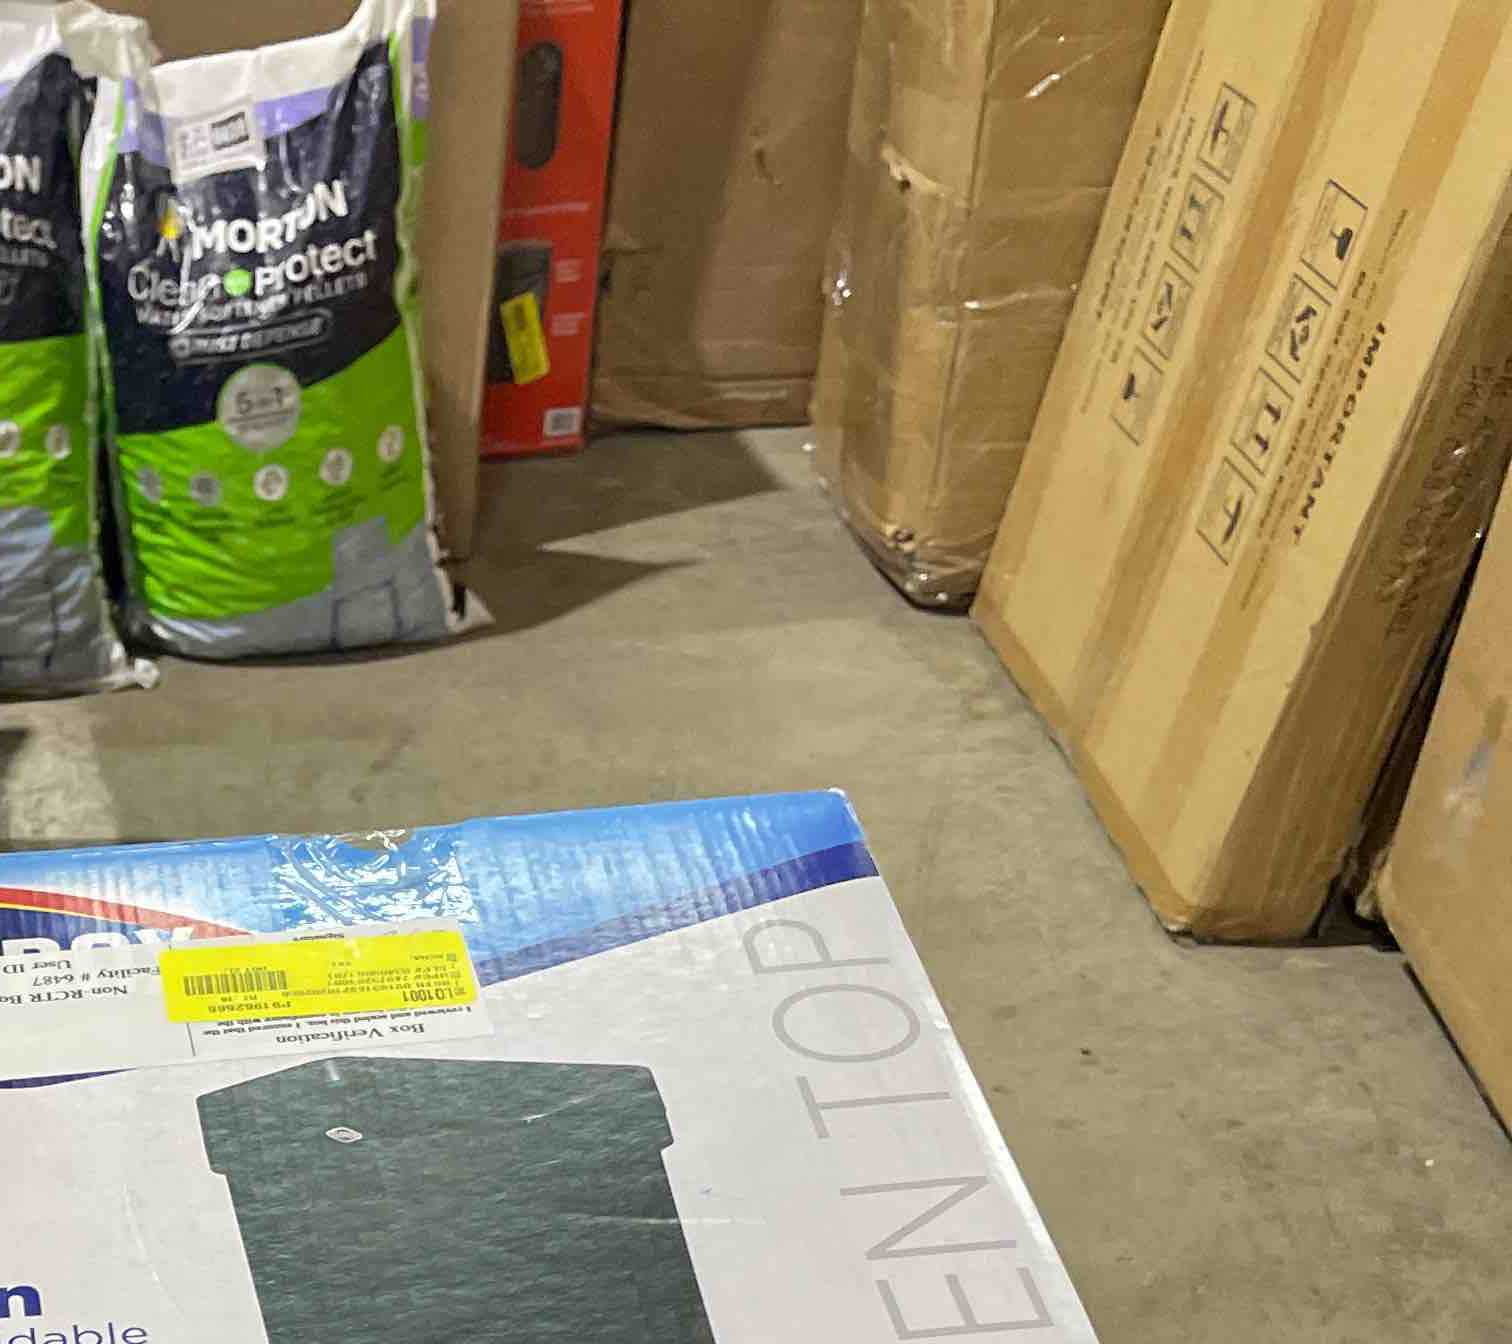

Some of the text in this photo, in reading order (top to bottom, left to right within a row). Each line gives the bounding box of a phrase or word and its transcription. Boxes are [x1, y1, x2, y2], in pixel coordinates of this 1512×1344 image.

[254, 230, 376, 296] Protect
[3, 963, 24, 974] ID
[32, 959, 71, 970] User
[97, 965, 161, 979] Facility
[32, 974, 74, 986] 6487
[29, 985, 128, 1003] Non-RCTR
[276, 1023, 423, 1044] Box Verification
[741, 918, 952, 1139] TOP
